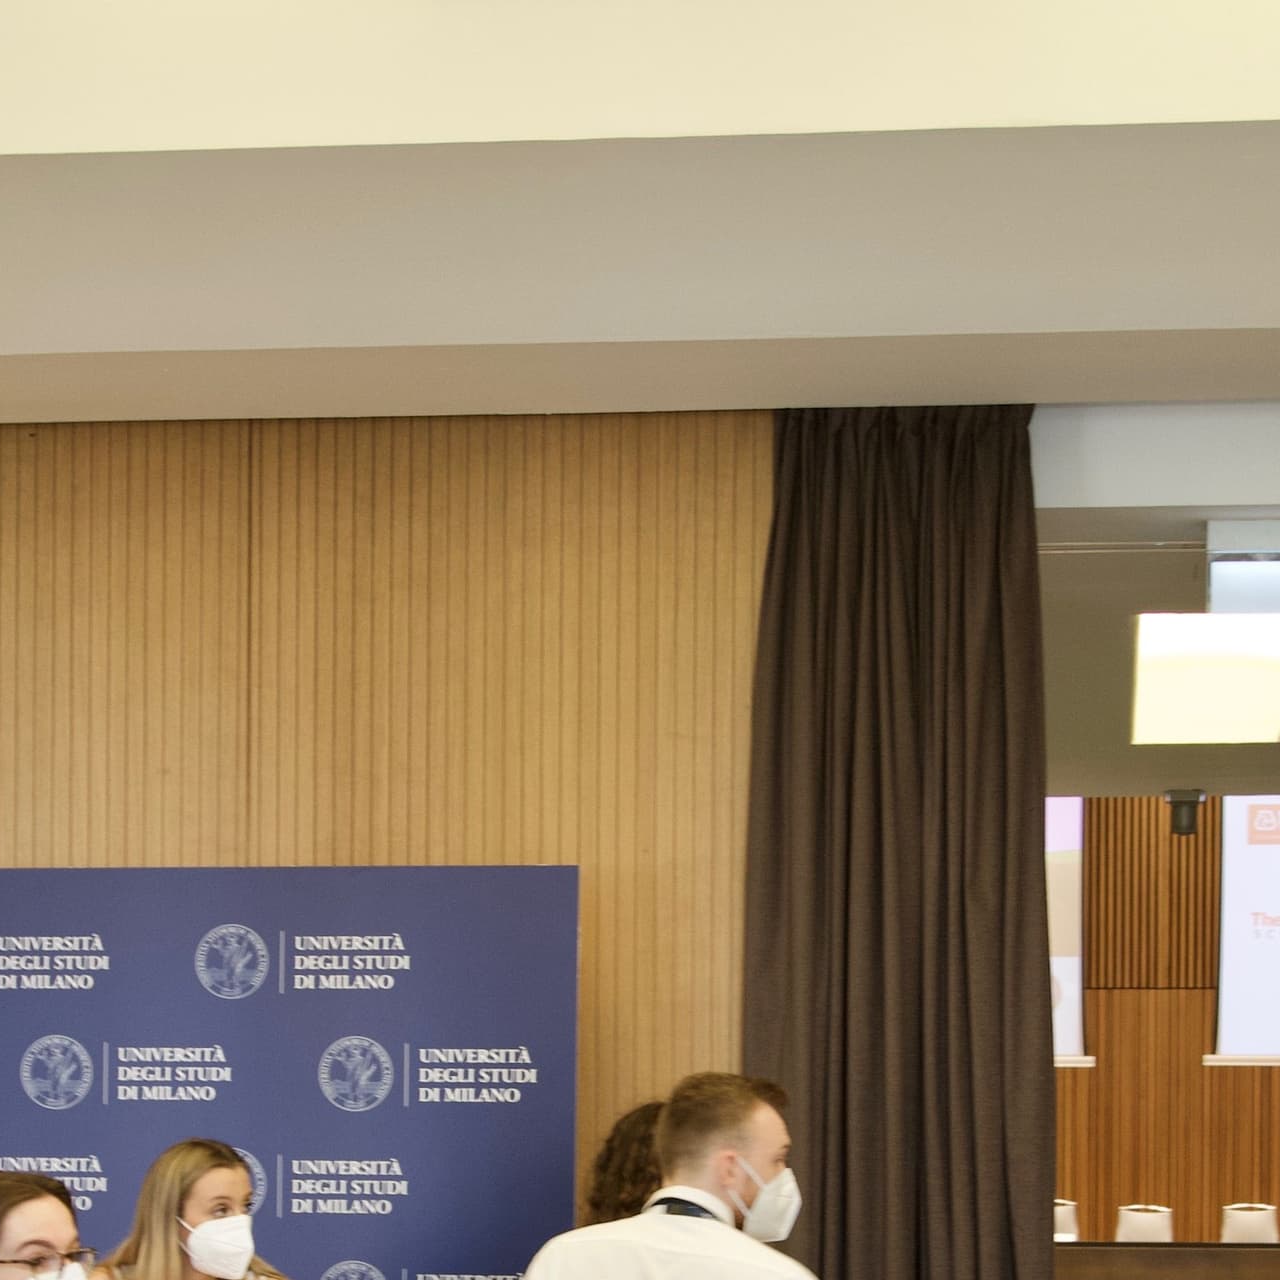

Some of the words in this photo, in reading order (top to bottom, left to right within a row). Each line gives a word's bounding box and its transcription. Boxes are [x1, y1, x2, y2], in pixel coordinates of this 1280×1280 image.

[294, 933, 405, 950] UNIVERSITÀ
[53, 956, 110, 970] STUDI
[294, 955, 350, 969] DEGLI
[352, 955, 411, 969] STUDI
[20, 975, 95, 989] MILANO
[294, 975, 316, 989] DI
[318, 975, 395, 989] MILANO
[117, 1045, 227, 1062] UNIVERSITÀ
[419, 1046, 532, 1063] UNIVERSITÀ
[117, 1067, 172, 1081] DEGLI
[174, 1067, 232, 1081] STUDI
[419, 1068, 476, 1083] DEGLI
[478, 1068, 538, 1083] STUDI
[117, 1086, 139, 1100] DI
[141, 1086, 217, 1100] MILANO
[419, 1088, 441, 1102] DI
[443, 1088, 522, 1102] MILANO
[291, 1158, 403, 1175] UNIVERSITÀ
[56, 1177, 108, 1192] TUDI
[291, 1180, 348, 1195] DEGLI
[350, 1180, 409, 1195] STUDI
[291, 1199, 314, 1214] DI
[316, 1199, 393, 1214] MILANO
